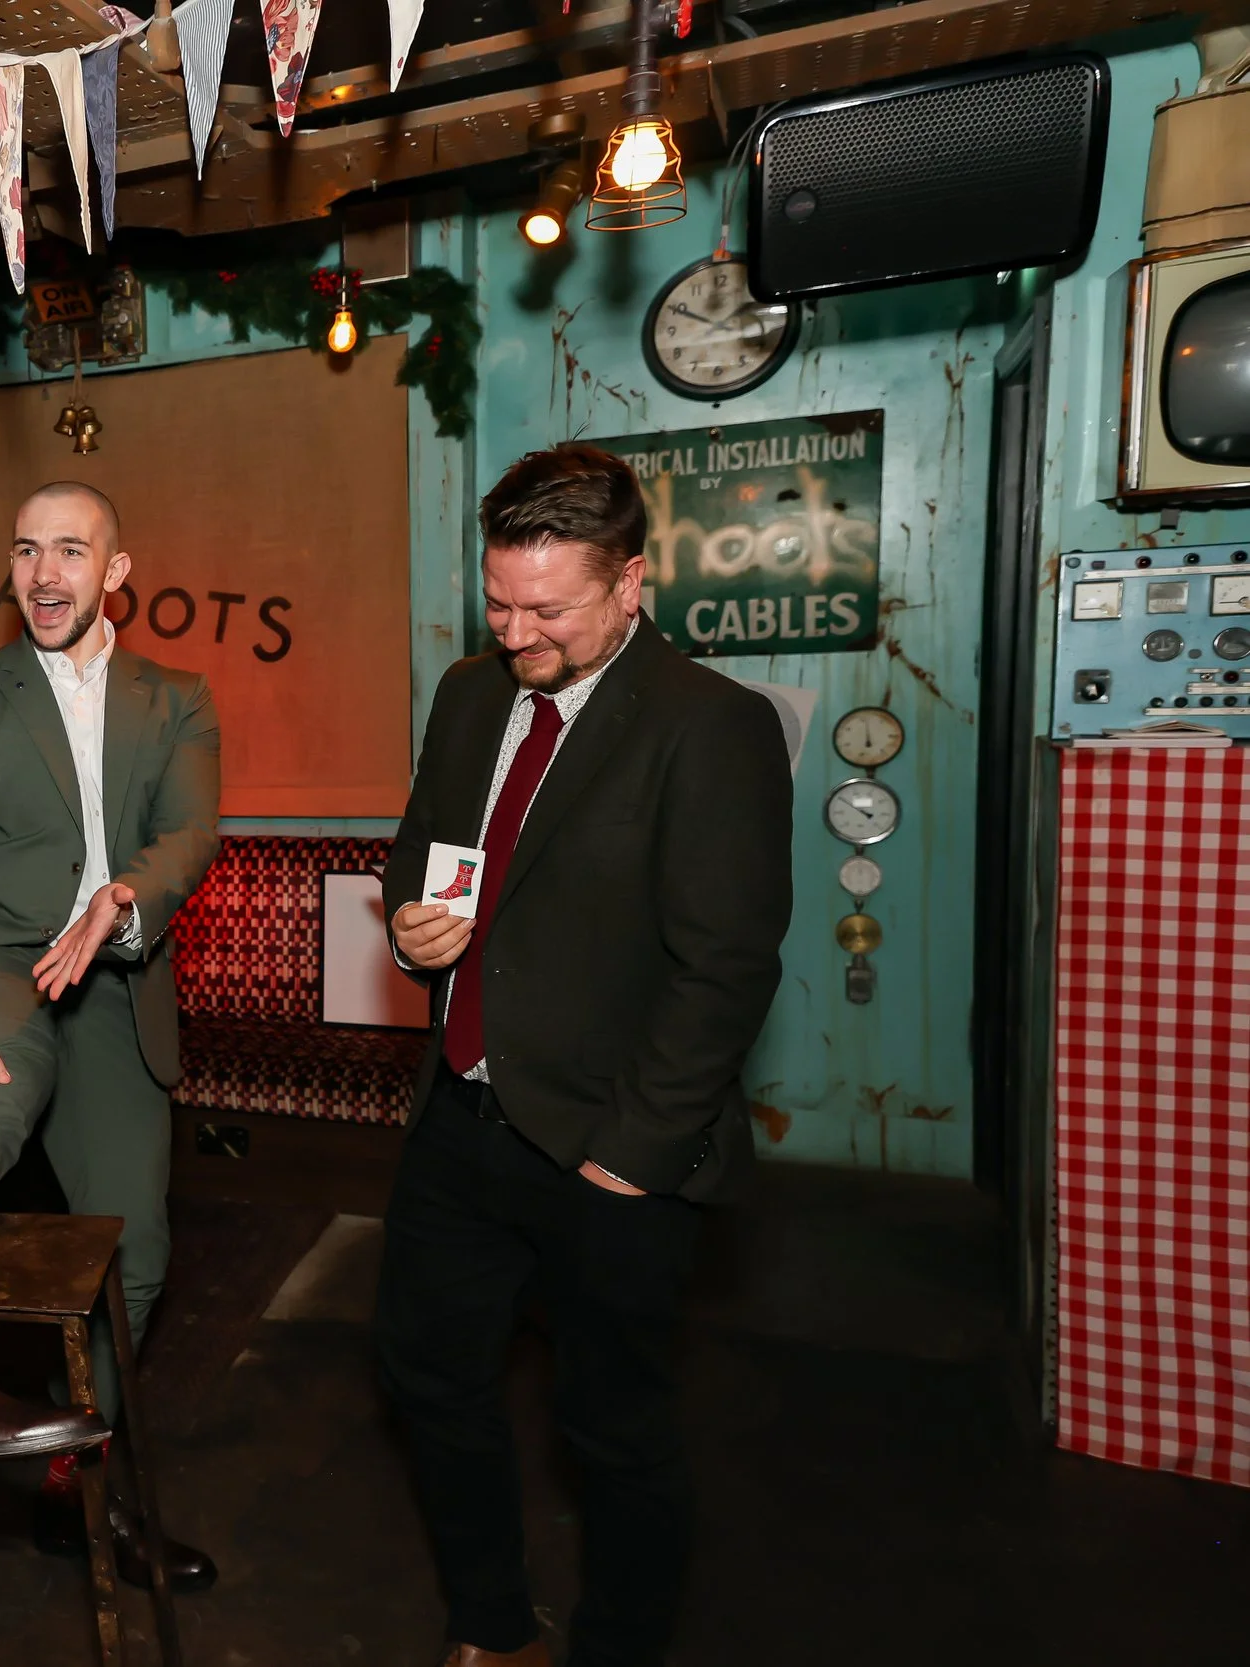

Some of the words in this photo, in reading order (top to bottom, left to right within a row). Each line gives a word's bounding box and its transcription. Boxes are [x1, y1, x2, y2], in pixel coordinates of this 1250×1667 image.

[714, 274, 728, 288] 12
[42, 286, 79, 301] ON
[691, 284, 702, 296] 11
[46, 301, 88, 318] AIR
[667, 325, 677, 336] 9
[673, 347, 682, 360] 8
[689, 360, 698, 373] 7
[713, 365, 724, 377] 6
[622, 447, 699, 480] TRICAL
[707, 431, 867, 474] INSTALLATION
[699, 477, 722, 490] BY
[685, 593, 862, 643] CABLES
